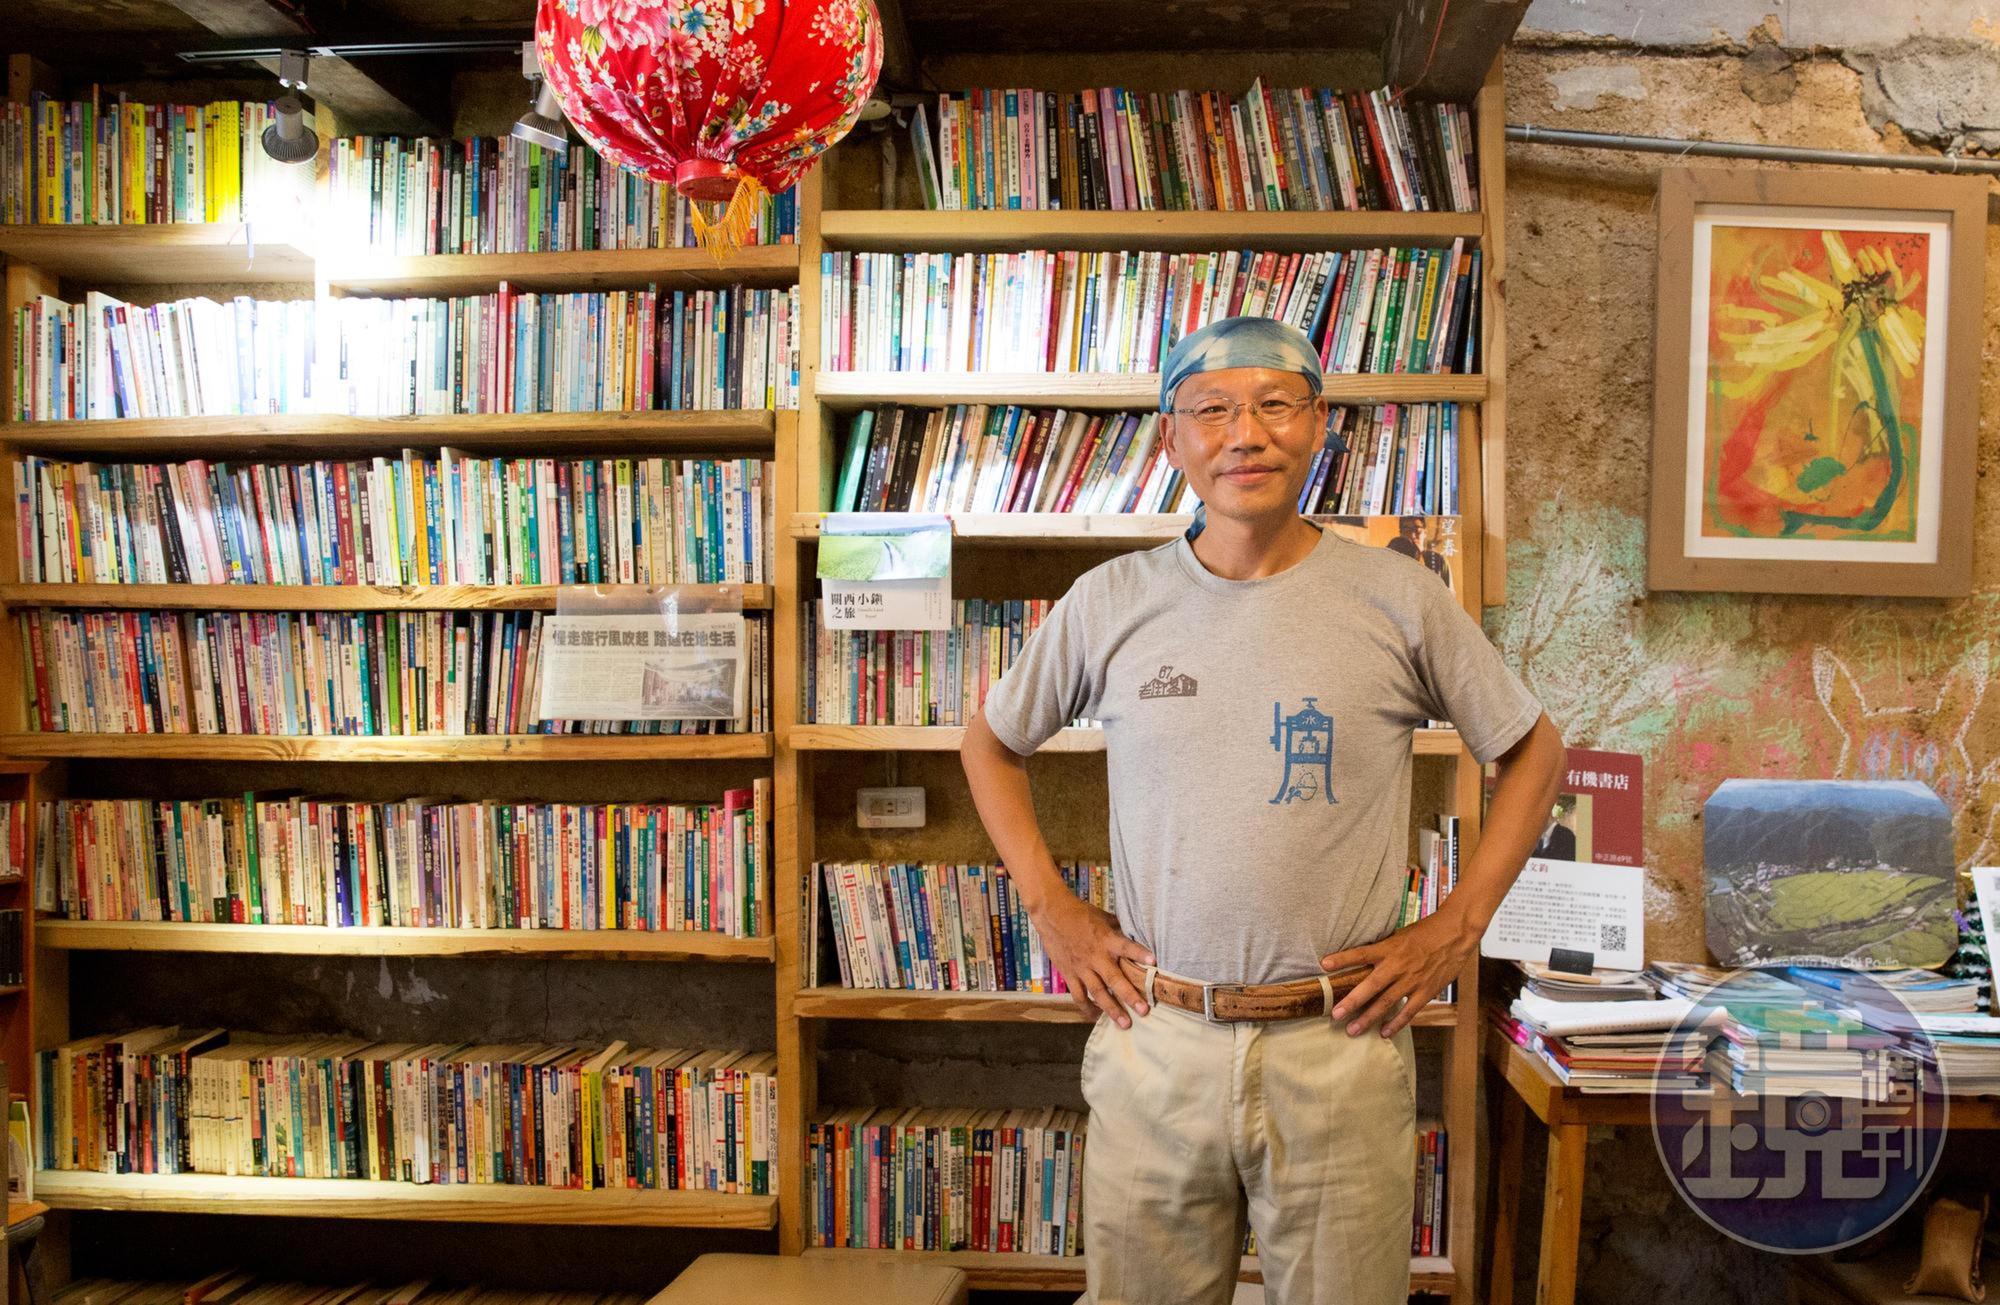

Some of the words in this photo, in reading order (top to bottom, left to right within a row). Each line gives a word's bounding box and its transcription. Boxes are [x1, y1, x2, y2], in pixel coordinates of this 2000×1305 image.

[831, 592, 883, 606] 關西小鎮
[831, 606, 856, 619] 之旅
[553, 629, 649, 647] 慢走旅行風吹起
[1158, 665, 1174, 679] 67
[1567, 769, 1630, 790] 有機書店
[1821, 956, 1837, 969] by
